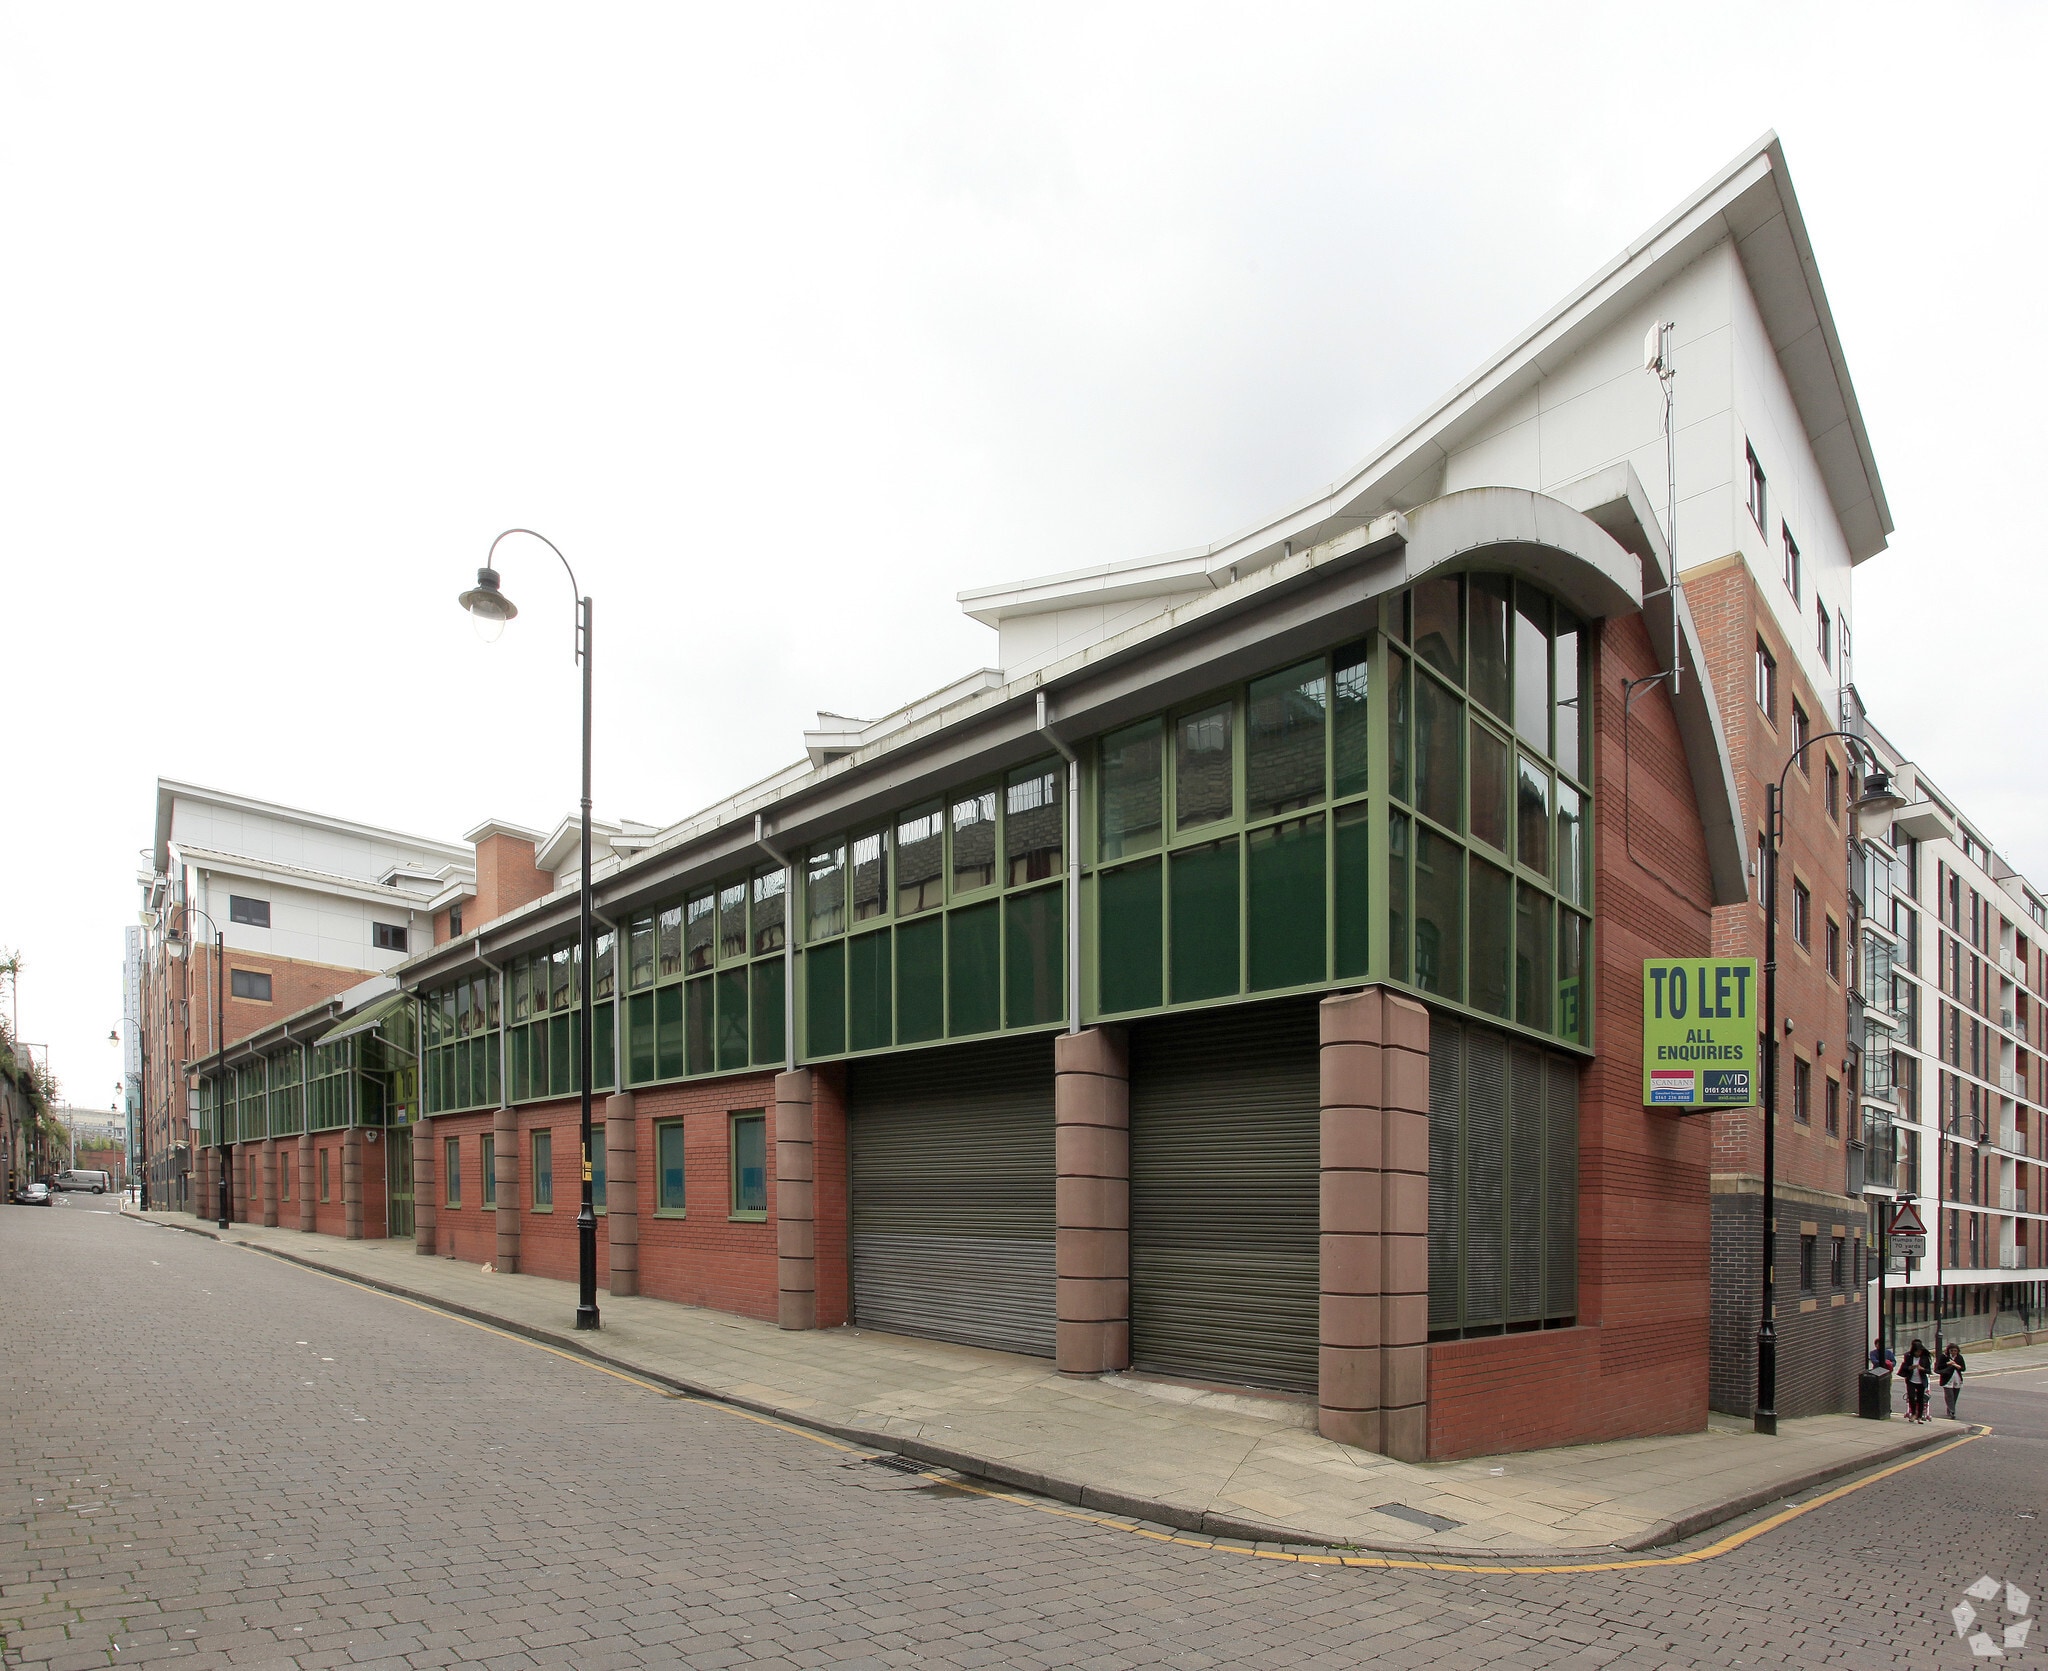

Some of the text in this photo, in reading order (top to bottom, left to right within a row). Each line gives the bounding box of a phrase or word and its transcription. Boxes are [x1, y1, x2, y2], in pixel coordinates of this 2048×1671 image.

[1650, 966, 1751, 1020] TO LET
[1686, 1029, 1715, 1043] ALL
[1657, 1045, 1744, 1061] ENQUIRIES
[1718, 1073, 1748, 1086] AVID
